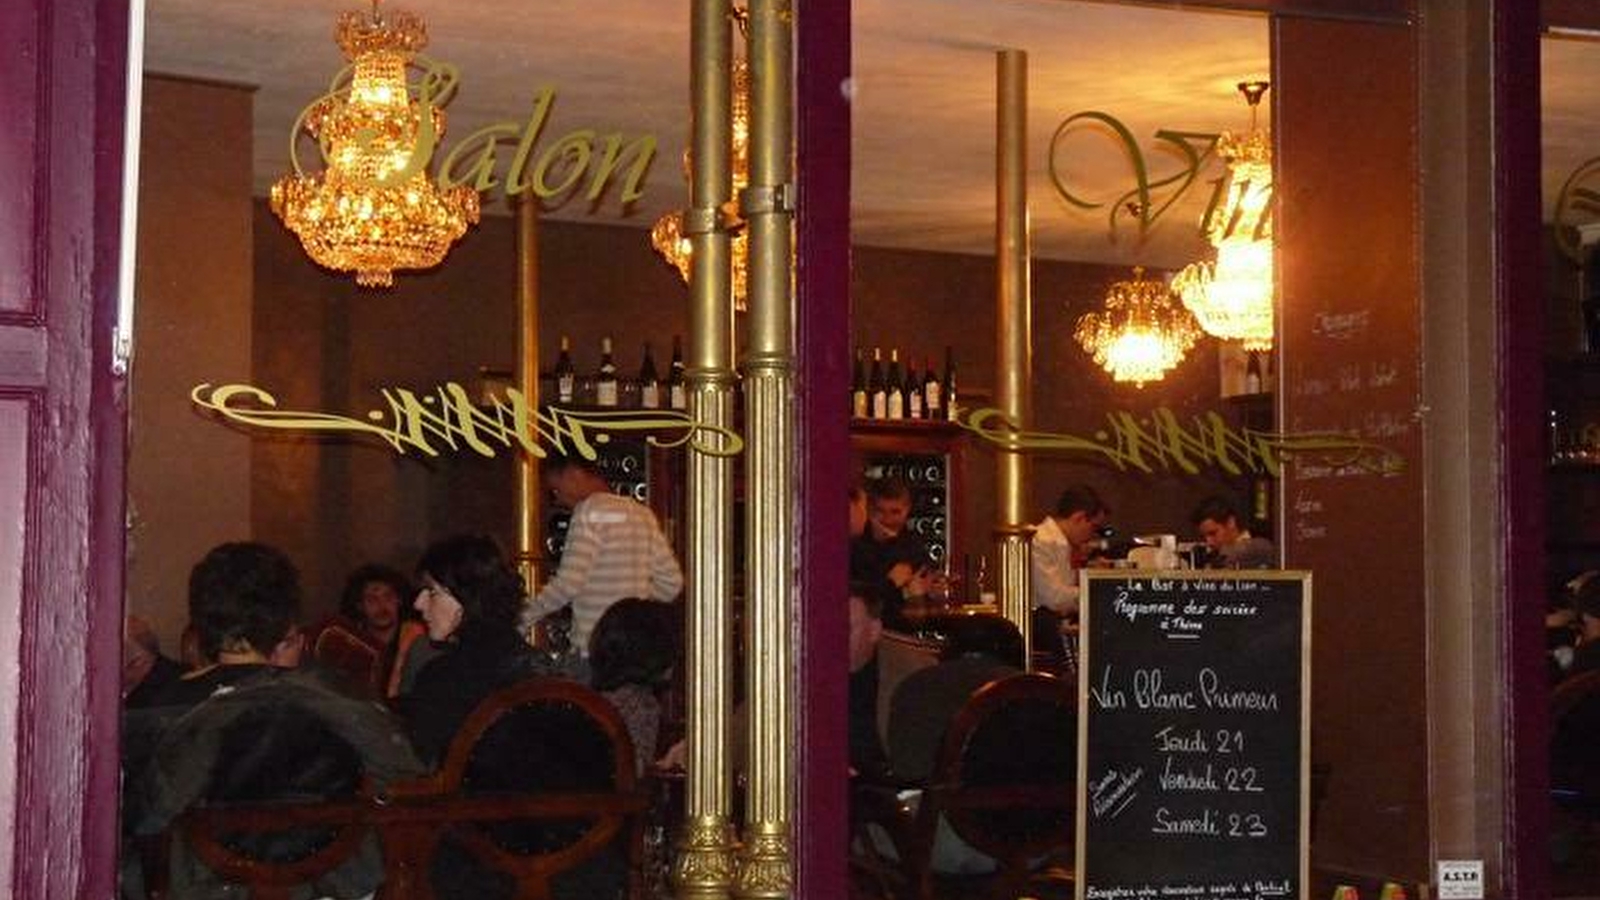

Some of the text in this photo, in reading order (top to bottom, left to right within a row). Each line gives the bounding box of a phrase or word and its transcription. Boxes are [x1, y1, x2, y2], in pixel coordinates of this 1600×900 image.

[290, 54, 657, 202] Salon
[1183, 600, 1206, 615] des
[1092, 665, 1279, 711] Vin Blanc Primeur
[1217, 729, 1244, 753] 21
[1225, 767, 1264, 791] 22
[1152, 807, 1267, 837] Samedi 23
